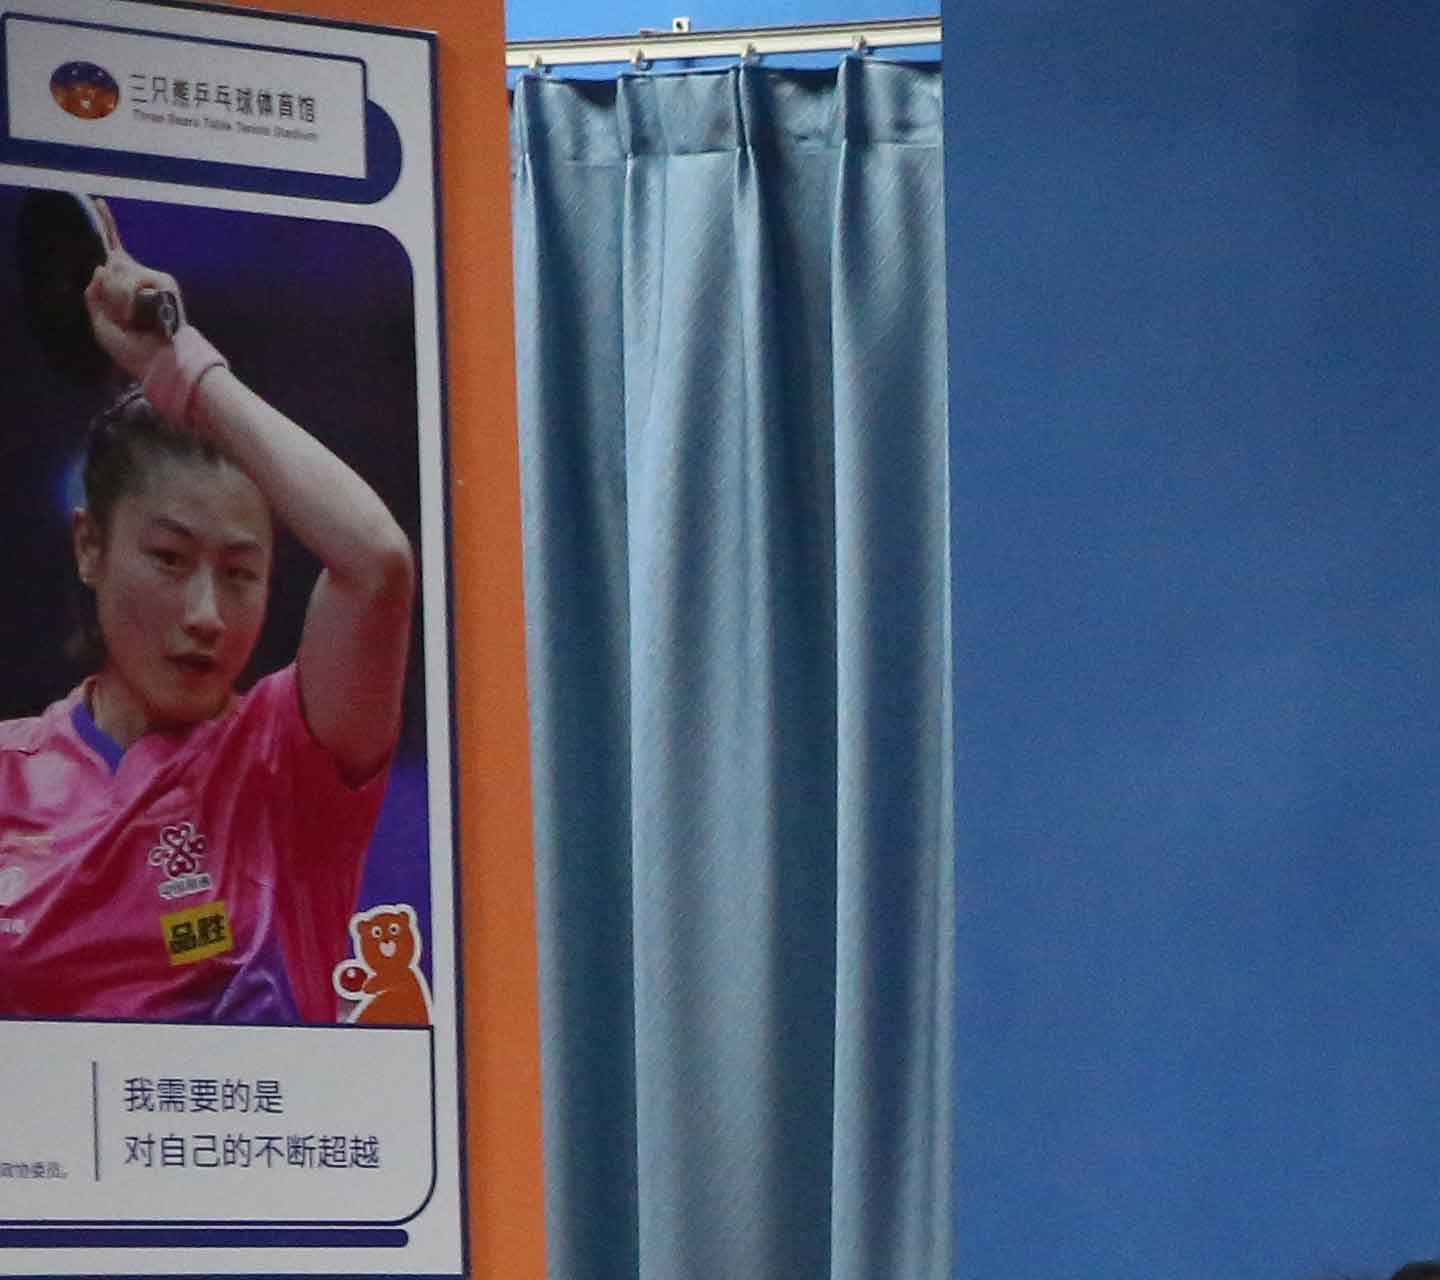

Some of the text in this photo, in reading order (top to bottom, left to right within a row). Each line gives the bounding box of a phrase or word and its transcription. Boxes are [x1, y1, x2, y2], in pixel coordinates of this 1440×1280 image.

[124, 1078, 284, 1114] 我需要的是
[124, 1133, 380, 1169] 对自己的不断超越
